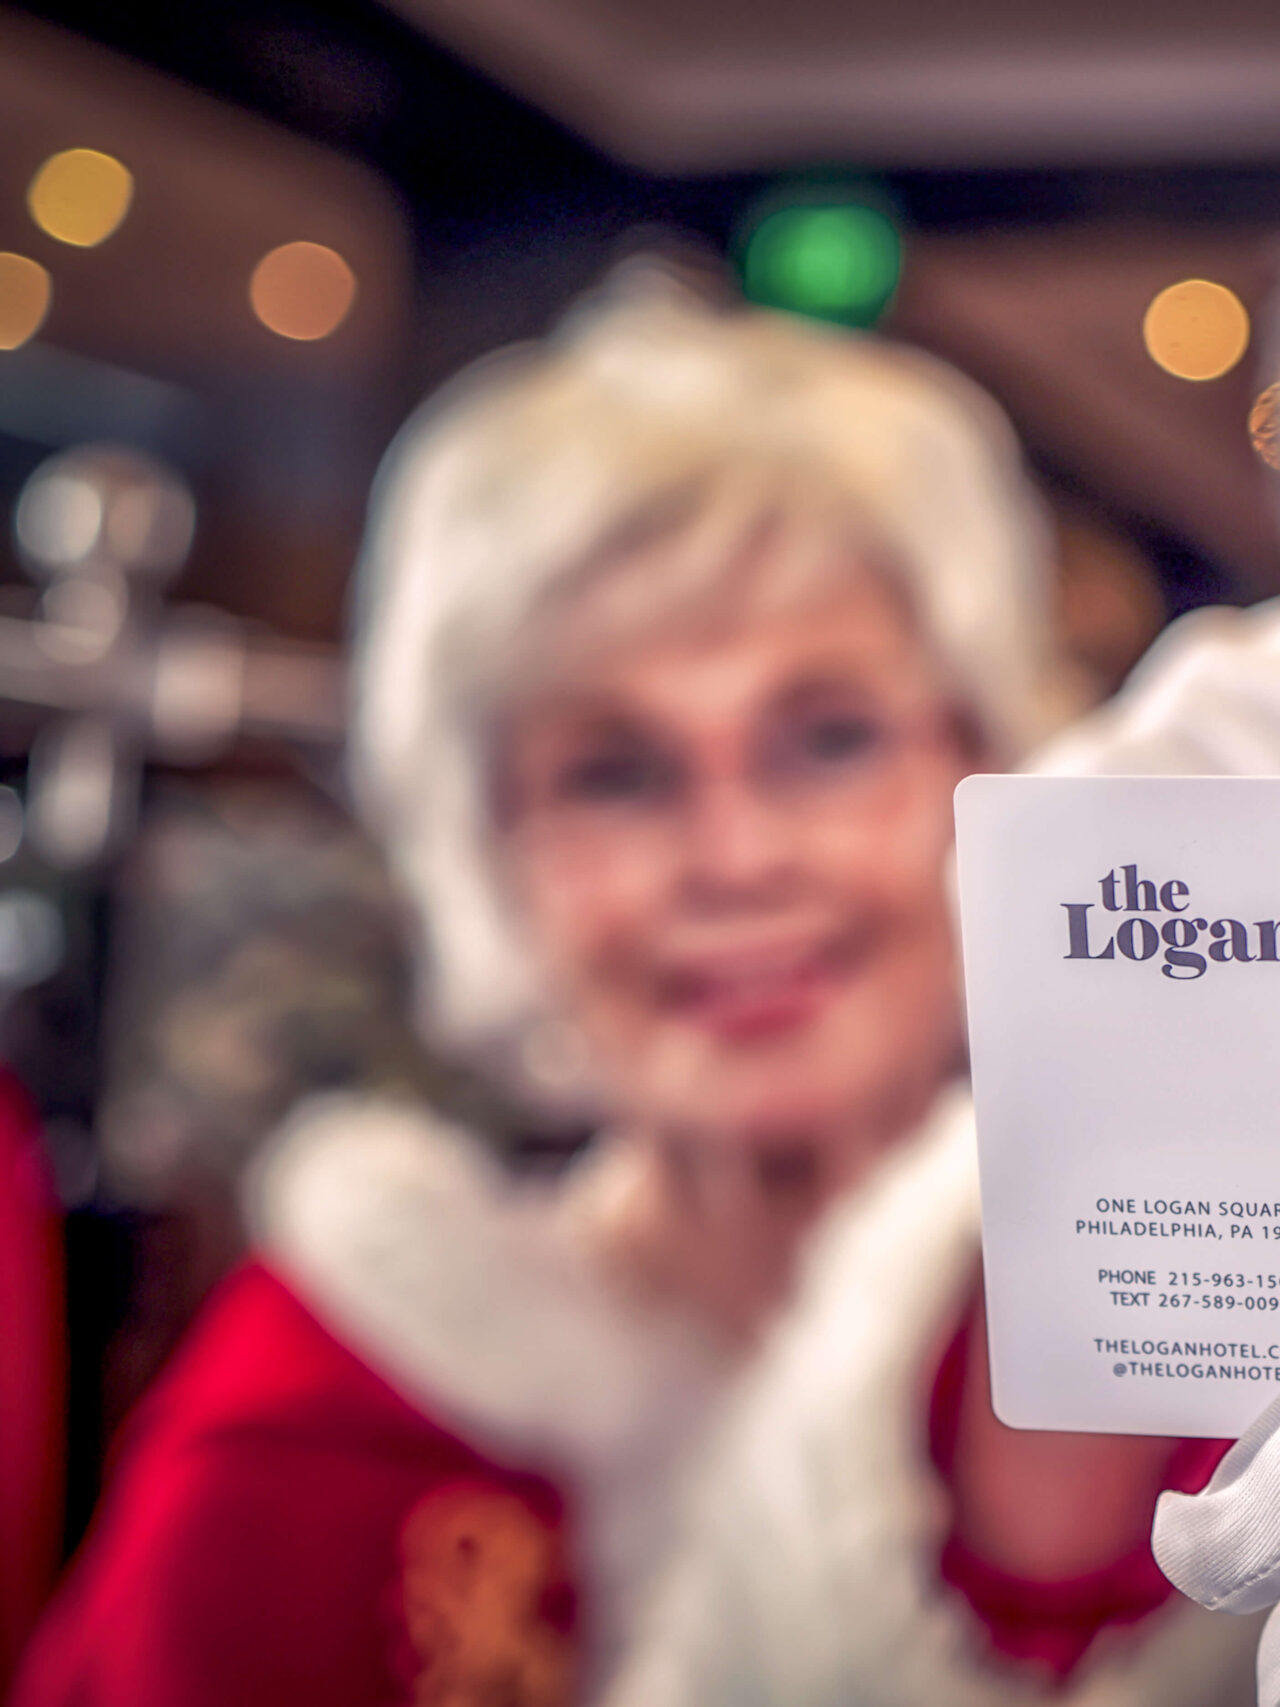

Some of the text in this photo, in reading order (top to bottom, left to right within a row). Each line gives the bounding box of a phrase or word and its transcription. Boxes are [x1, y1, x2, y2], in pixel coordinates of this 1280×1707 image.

[1098, 864, 1190, 912] the
[1096, 1198, 1136, 1215] ONE
[1143, 1199, 1211, 1216] LOGAN
[1075, 1219, 1223, 1241] PHILADELPHIA,
[1230, 1223, 1254, 1239] PA
[1098, 1268, 1157, 1286] PHONE
[1109, 1291, 1151, 1307] TEXT
